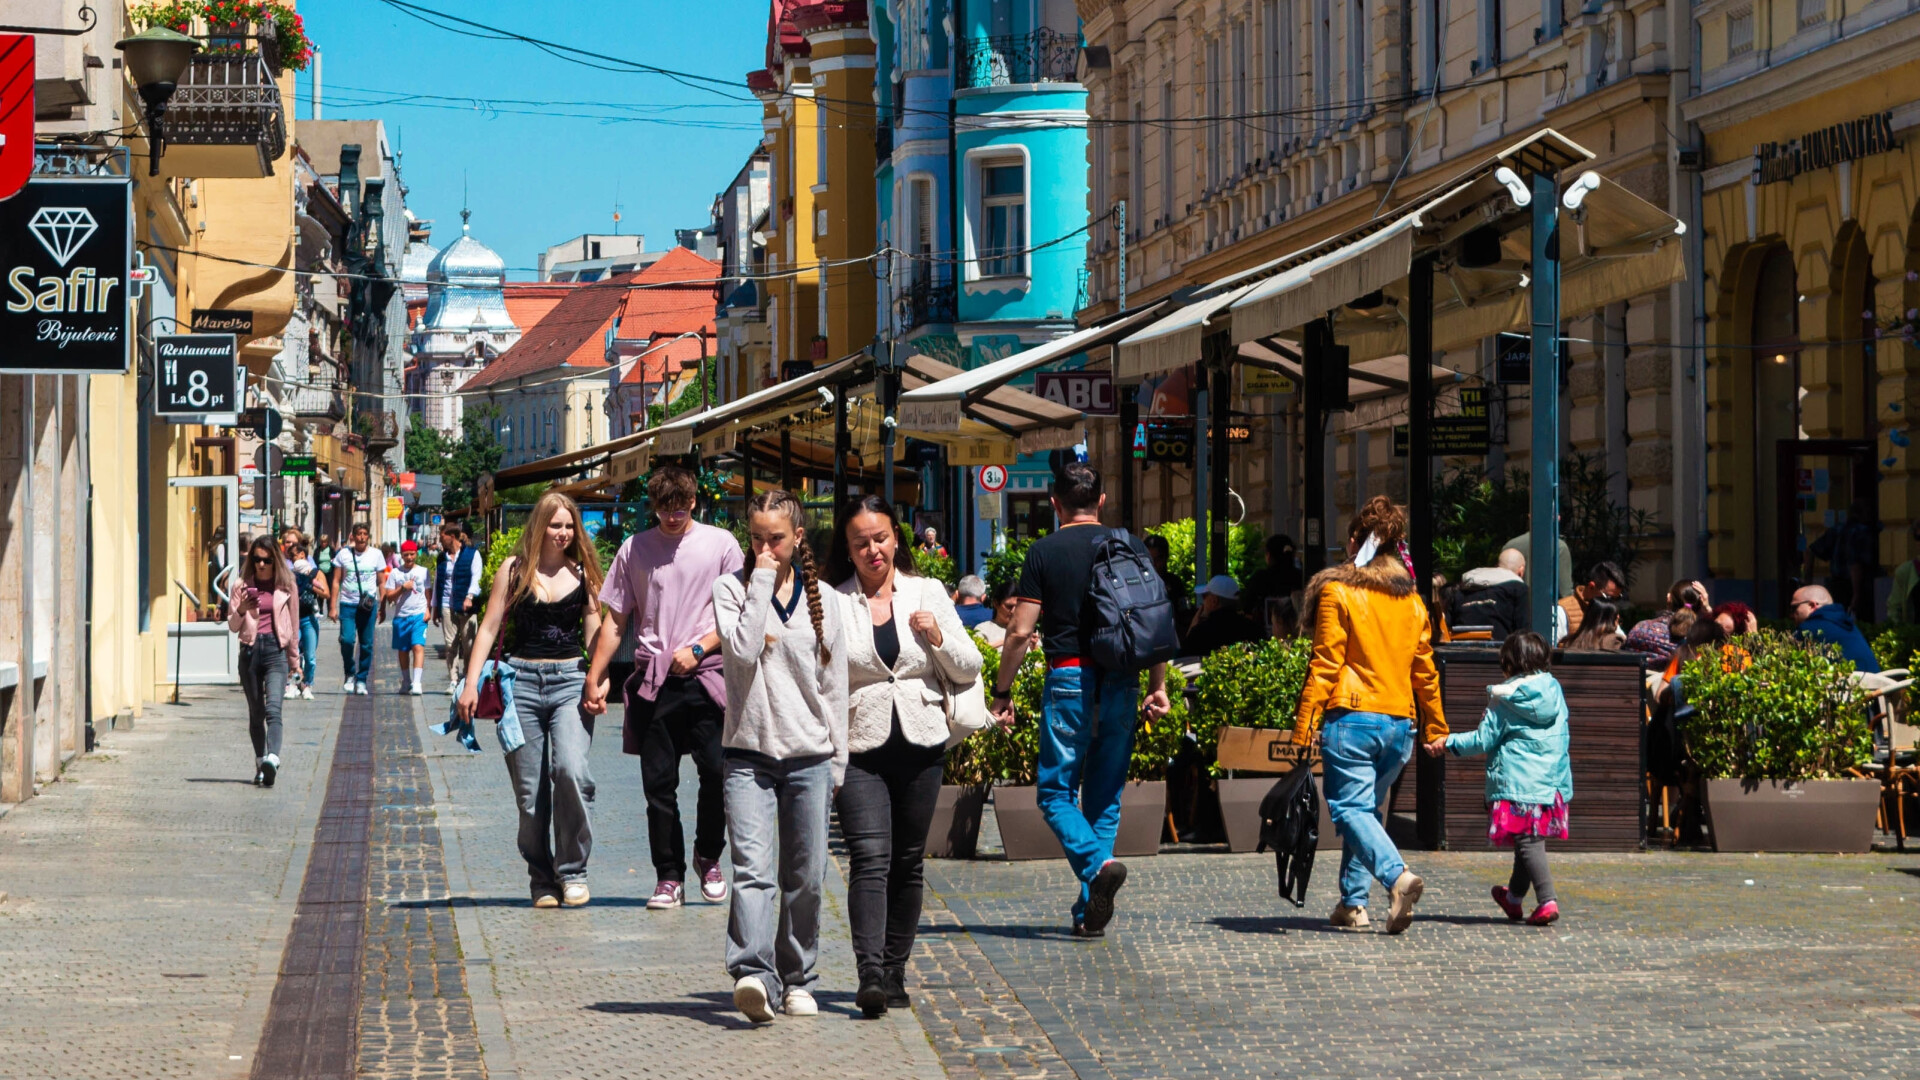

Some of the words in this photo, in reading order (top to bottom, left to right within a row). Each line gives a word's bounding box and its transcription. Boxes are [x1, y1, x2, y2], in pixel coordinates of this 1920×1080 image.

[1800, 112, 1893, 171] HUMANITAS
[7, 266, 119, 312] Safir
[36, 319, 119, 349] Bijuterii
[194, 314, 252, 329] Marelbo
[159, 343, 232, 356] Restaurant
[170, 392, 187, 405] La
[187, 369, 210, 408] 8
[211, 391, 225, 407] pt
[1044, 378, 1110, 409] ABC
